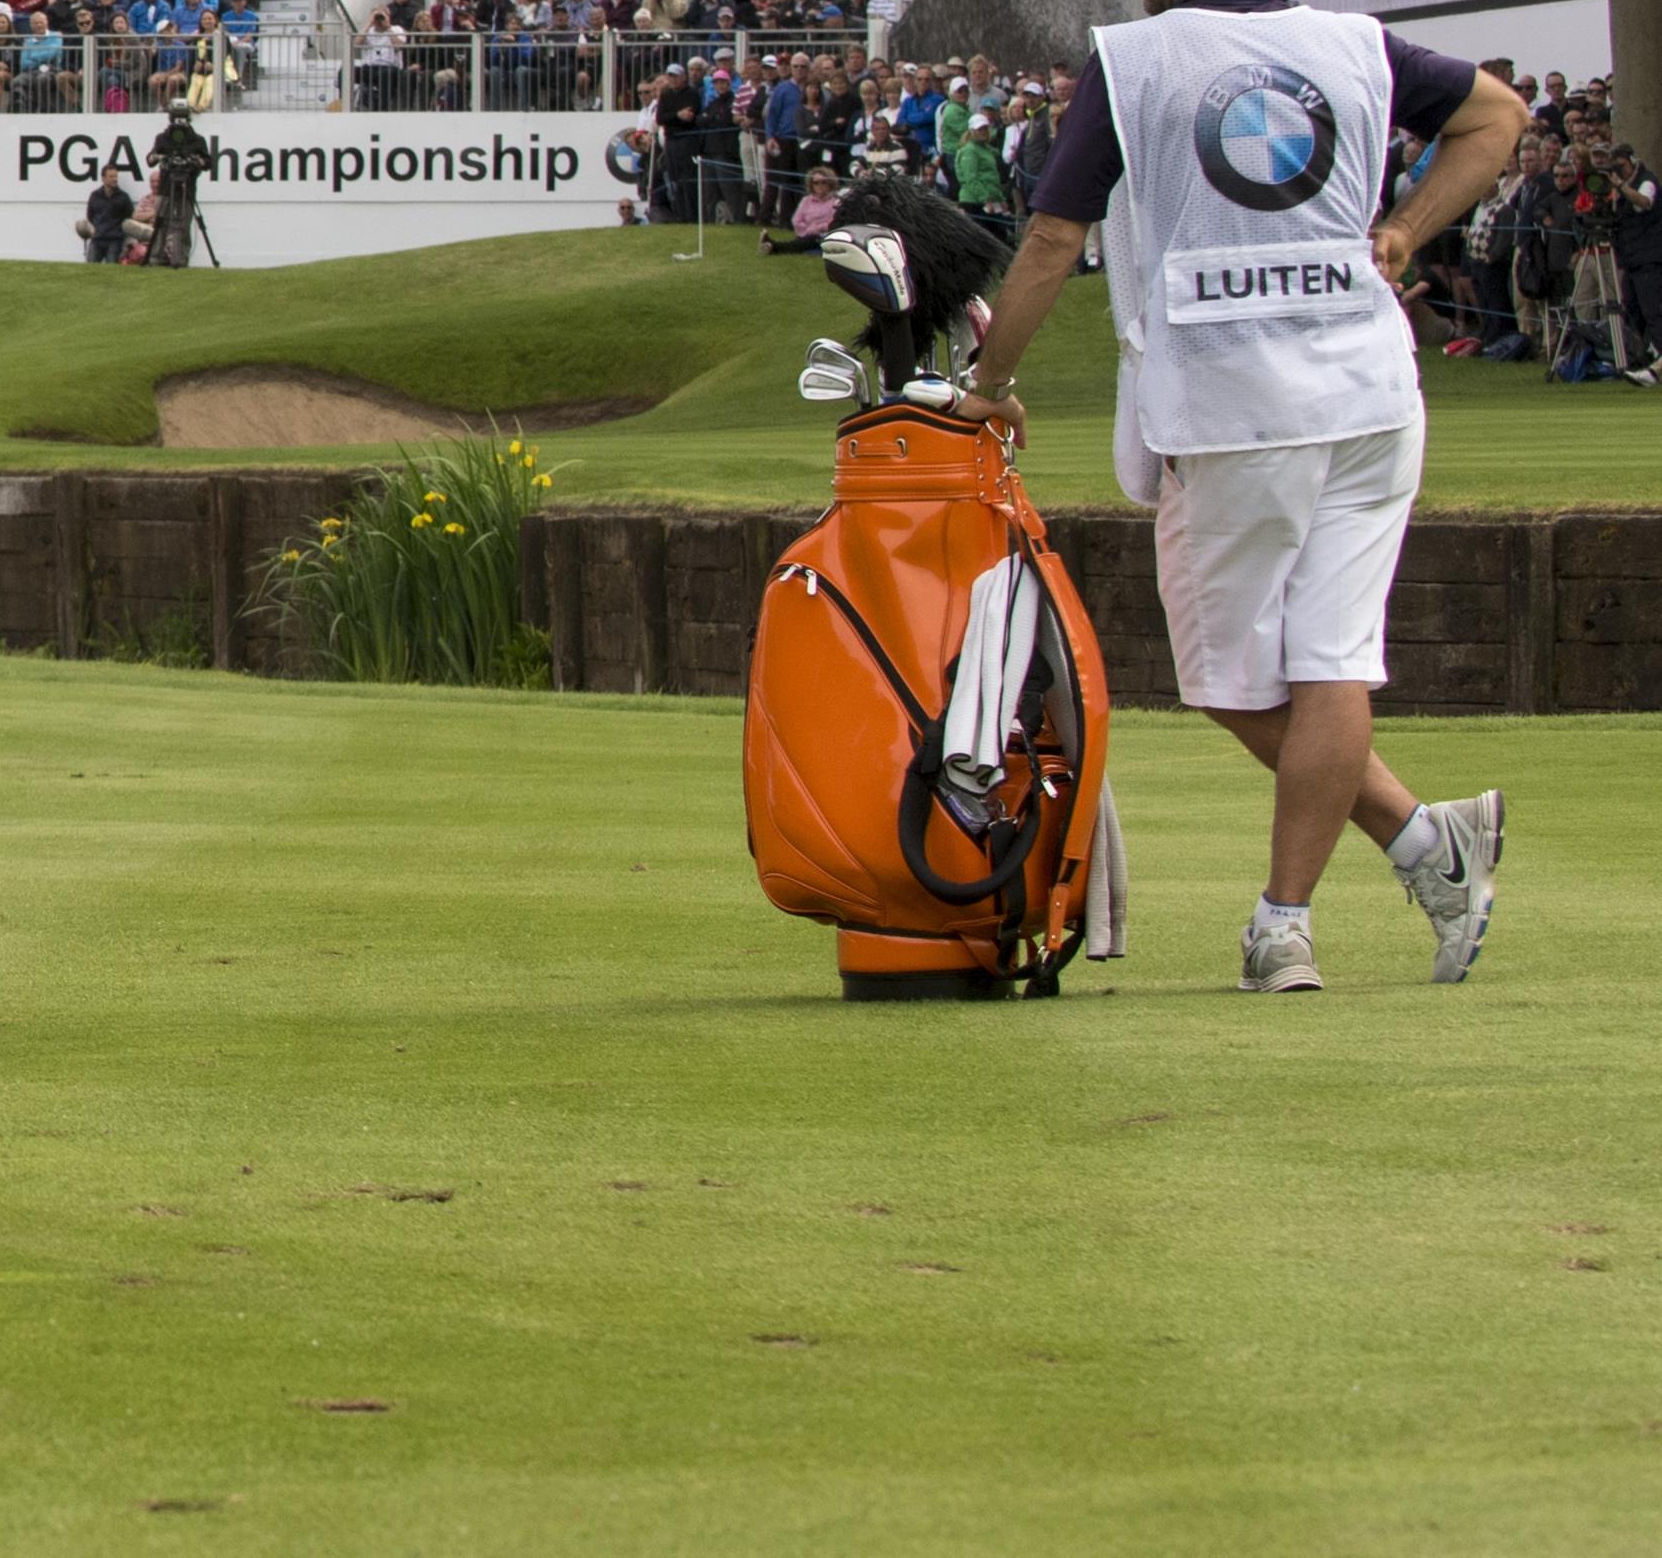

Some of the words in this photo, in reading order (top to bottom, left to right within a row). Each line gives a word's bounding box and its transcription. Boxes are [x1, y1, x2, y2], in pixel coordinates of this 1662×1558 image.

[18, 135, 144, 182] PGA
[209, 133, 579, 193] hampionship
[1196, 262, 1352, 302] LUITEN
